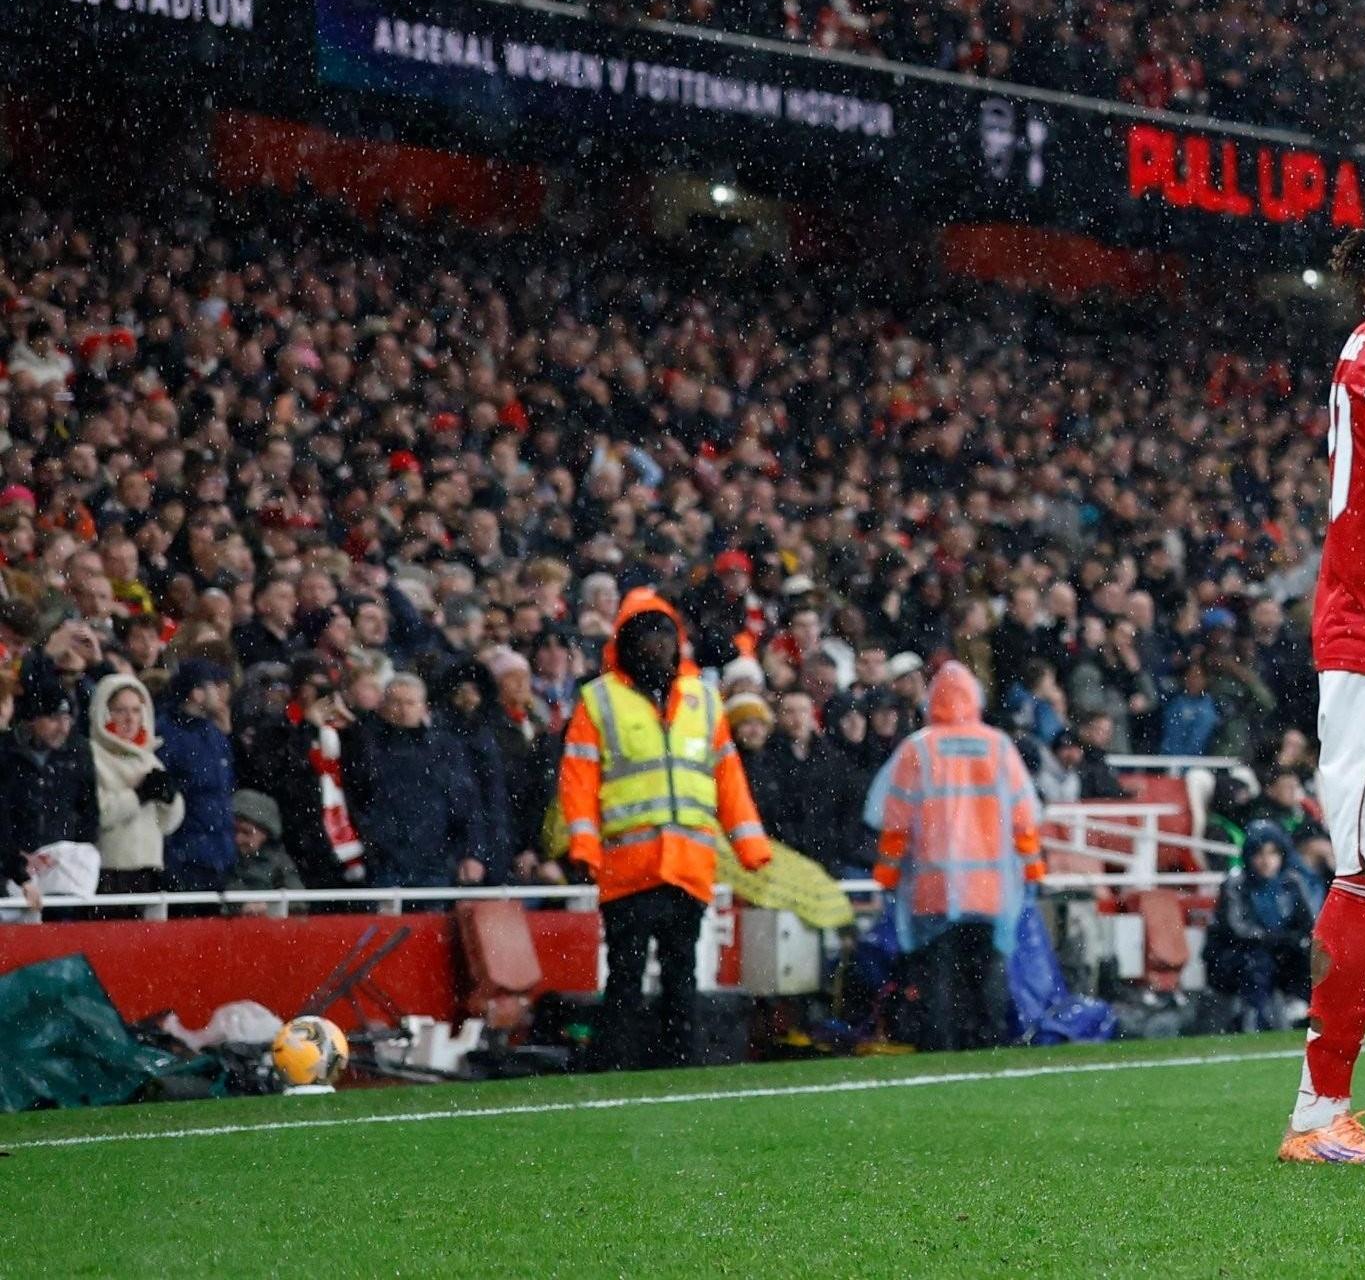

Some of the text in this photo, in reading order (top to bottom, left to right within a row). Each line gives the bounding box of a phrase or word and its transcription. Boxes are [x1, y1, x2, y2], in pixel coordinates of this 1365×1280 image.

[373, 17, 498, 74] ARSENAL
[1128, 123, 1252, 216] PULL
[1258, 145, 1326, 222] UP
